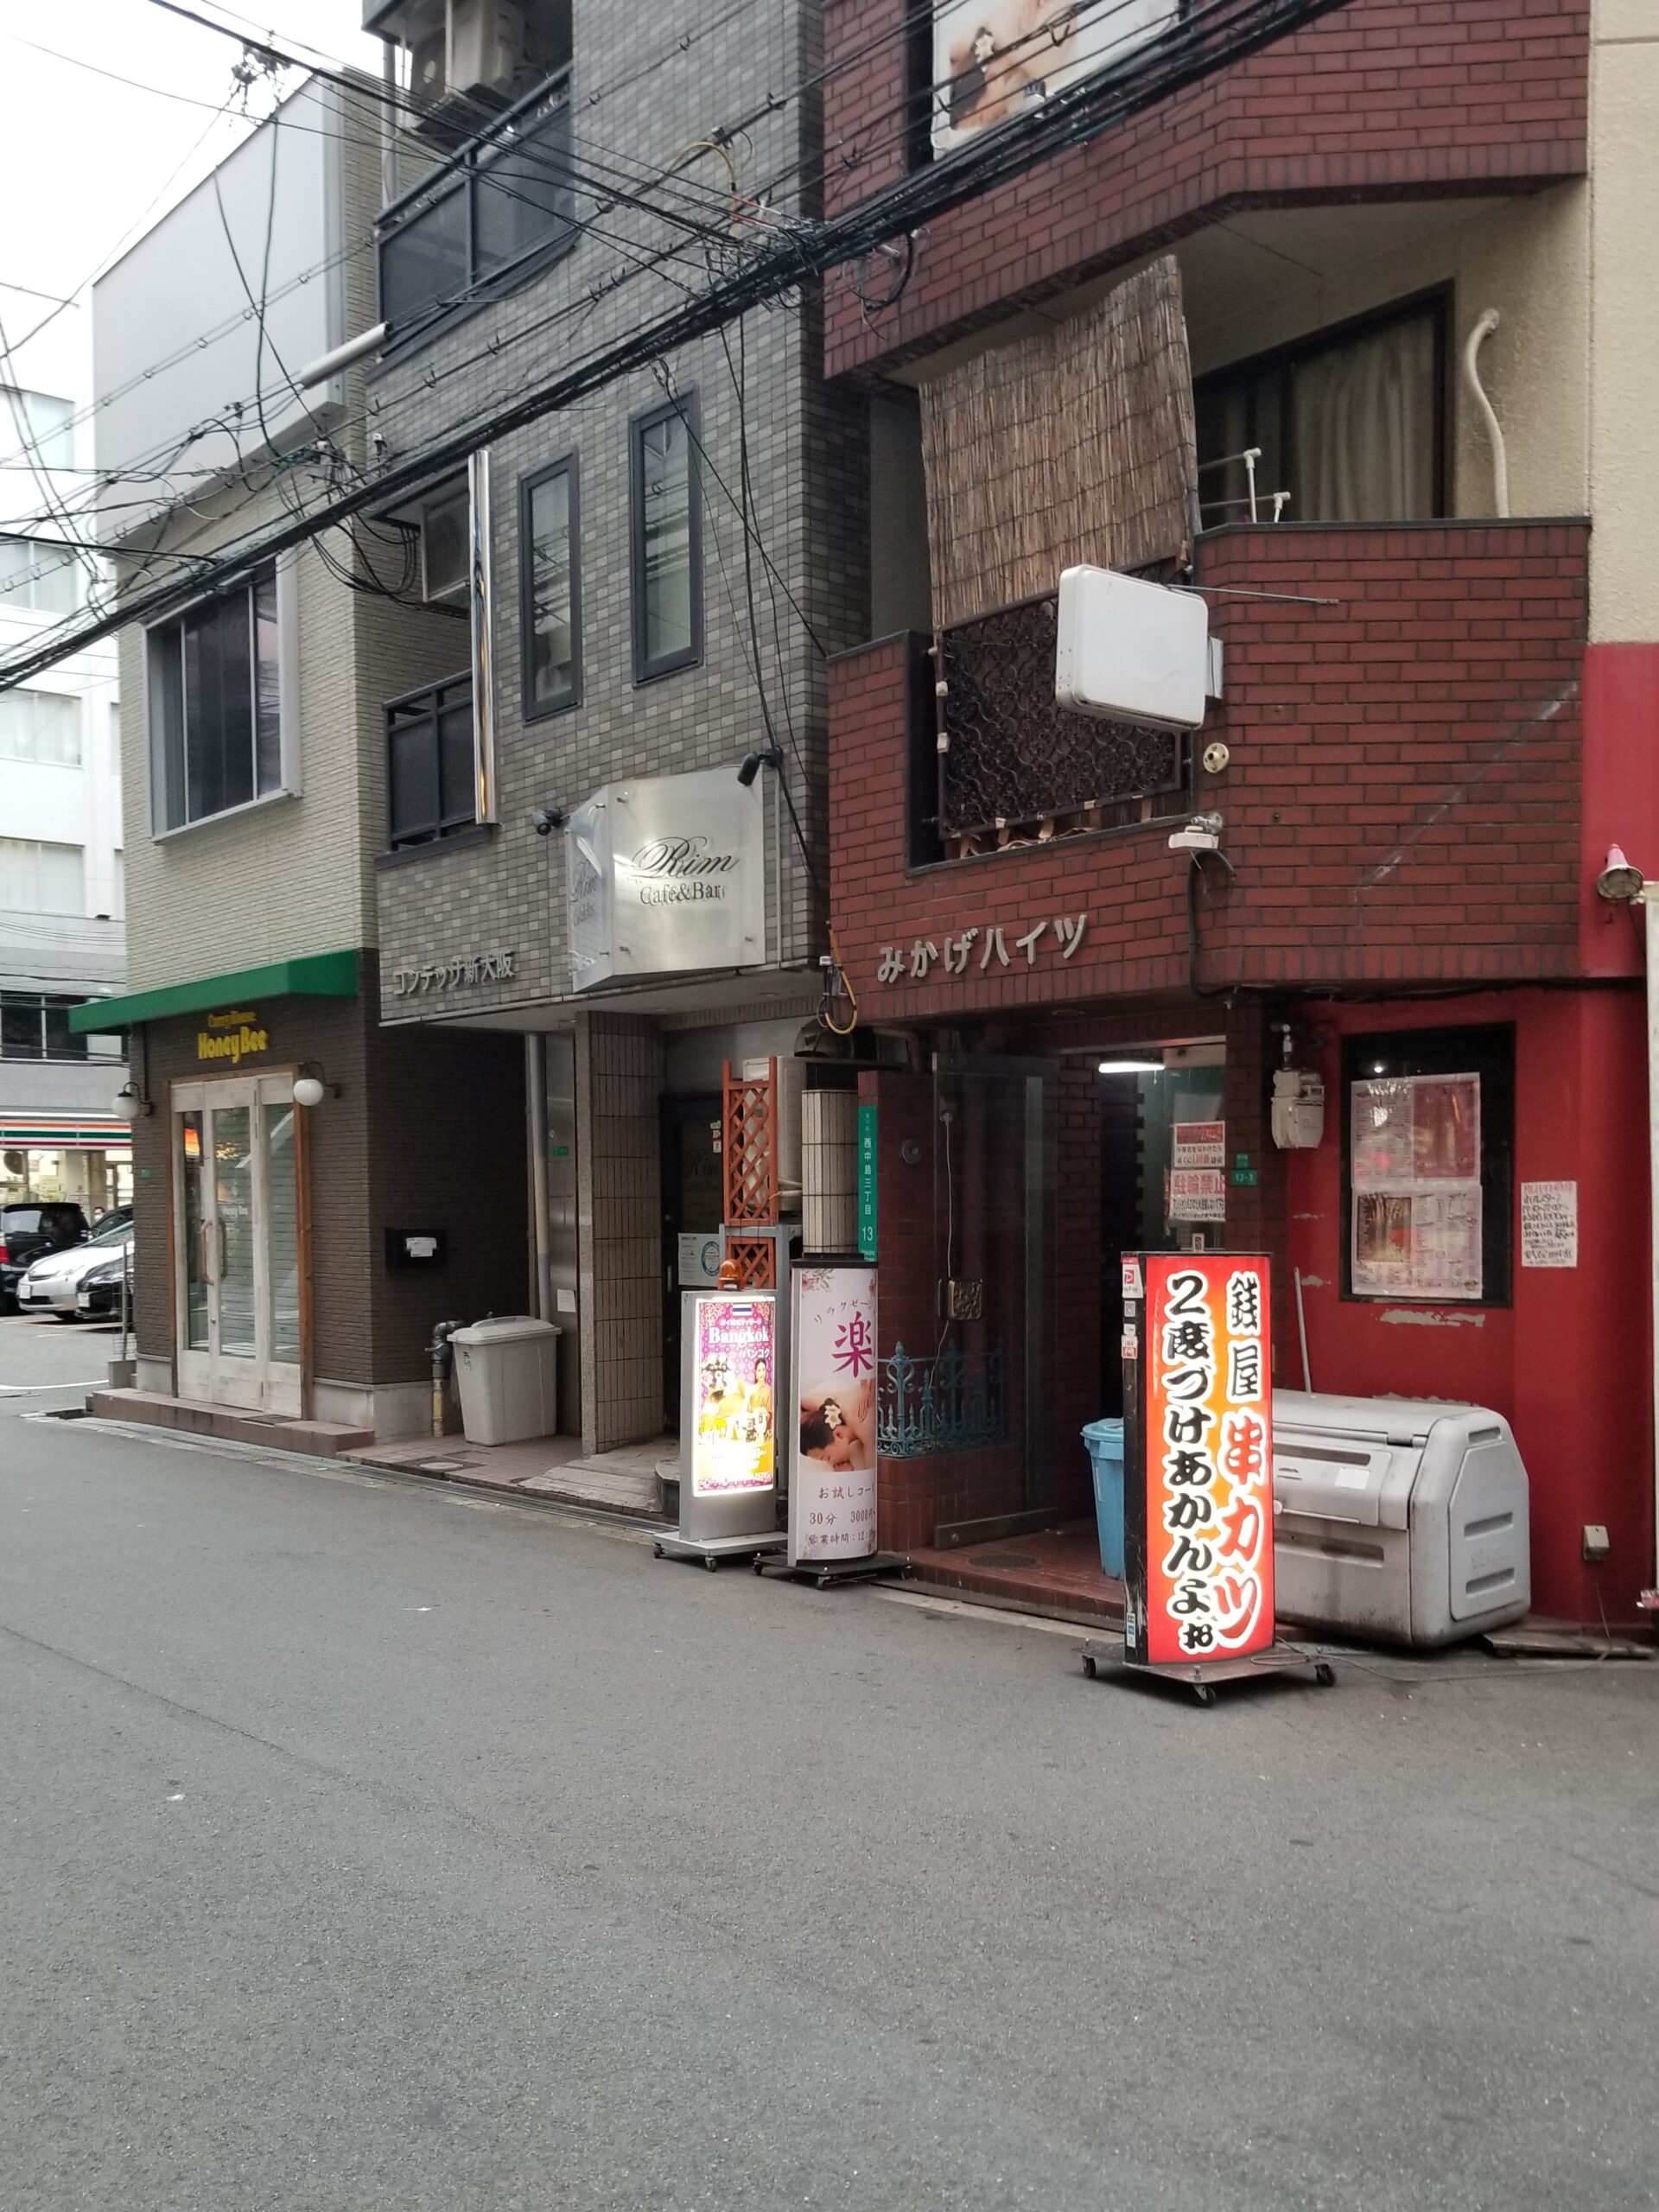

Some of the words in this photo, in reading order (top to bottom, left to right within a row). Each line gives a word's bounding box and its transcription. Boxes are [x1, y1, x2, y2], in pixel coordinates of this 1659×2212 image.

[631, 836, 740, 879] Rim
[640, 880, 722, 905] Cafe&Bar
[877, 914, 1087, 983] みかげハイツ
[393, 950, 515, 994] コンテッサ新大阪
[198, 1033, 240, 1064] Honey
[240, 1026, 267, 1054] Bee
[862, 1225, 874, 1242] 13
[709, 1325, 770, 1347] Bangkok
[830, 1310, 874, 1378] 楽
[809, 1512, 836, 1526] 30分
[1213, 1415, 1263, 1639] 串カツ
